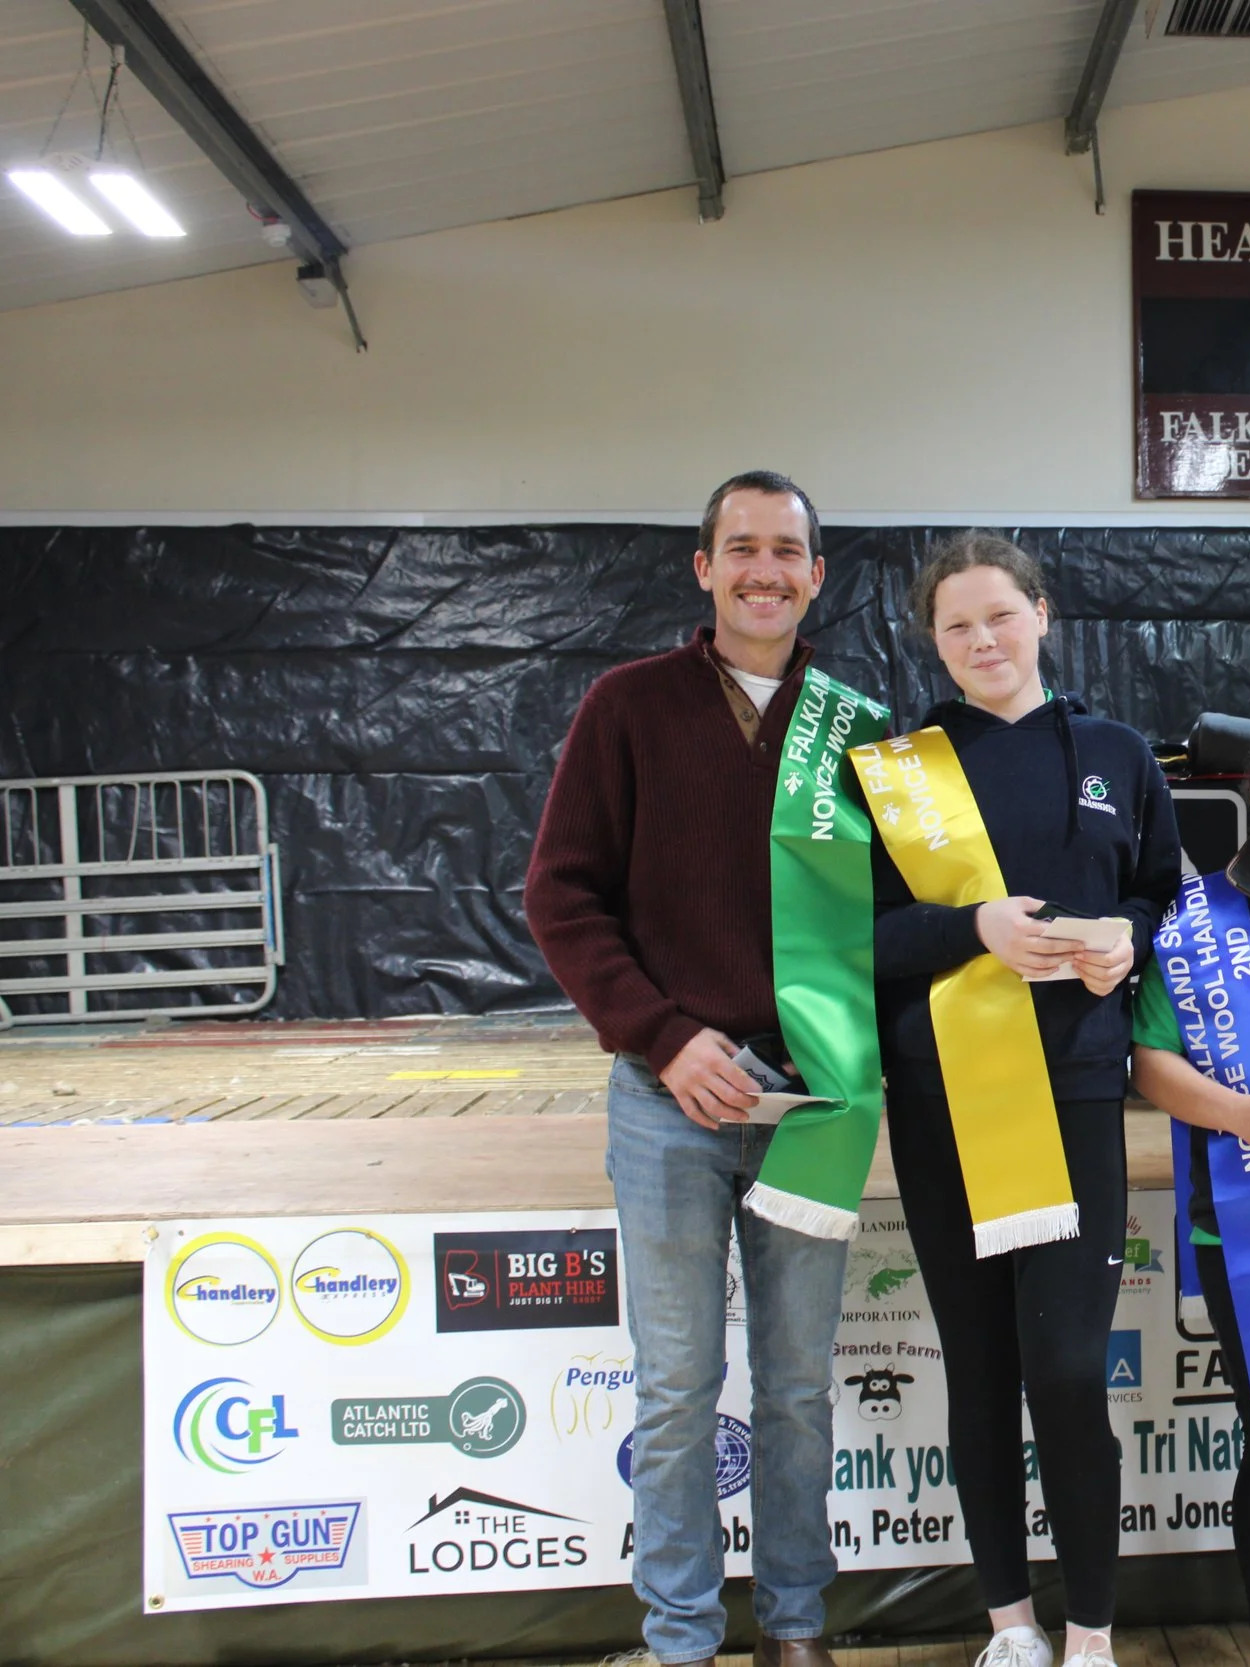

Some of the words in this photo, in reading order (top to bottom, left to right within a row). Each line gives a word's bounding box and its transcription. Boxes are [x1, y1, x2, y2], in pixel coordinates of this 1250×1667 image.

[897, 754, 950, 851] NOVICE
[1181, 873, 1220, 967] HANDLI
[1207, 969, 1240, 1059] WOOL
[861, 1220, 908, 1233] LANDH
[508, 1252, 558, 1278] BIG
[564, 1249, 606, 1277] B'S
[176, 1275, 276, 1303] Chandlery
[295, 1266, 397, 1294] Chandlery
[509, 1281, 563, 1297] PLANT
[565, 1280, 607, 1296] HIRE
[509, 1297, 532, 1306] JUST
[535, 1297, 551, 1305] DIG
[554, 1296, 564, 1305] IT
[897, 1340, 942, 1360] Farm
[216, 1394, 299, 1454] CFL
[343, 1404, 429, 1421] ATLANTIC
[344, 1422, 397, 1439] CATCH
[401, 1422, 431, 1438] LTD
[834, 1434, 896, 1491] ank
[1134, 1418, 1176, 1475] Tri
[184, 1521, 259, 1553] TOP
[271, 1517, 338, 1549] GUN
[476, 1514, 526, 1534] THE
[872, 1509, 955, 1546] Peter
[193, 1558, 254, 1571] SHEARING
[284, 1552, 339, 1565] SUPPLIES
[409, 1535, 588, 1575] LODGES
[252, 1569, 282, 1582] W.A.
